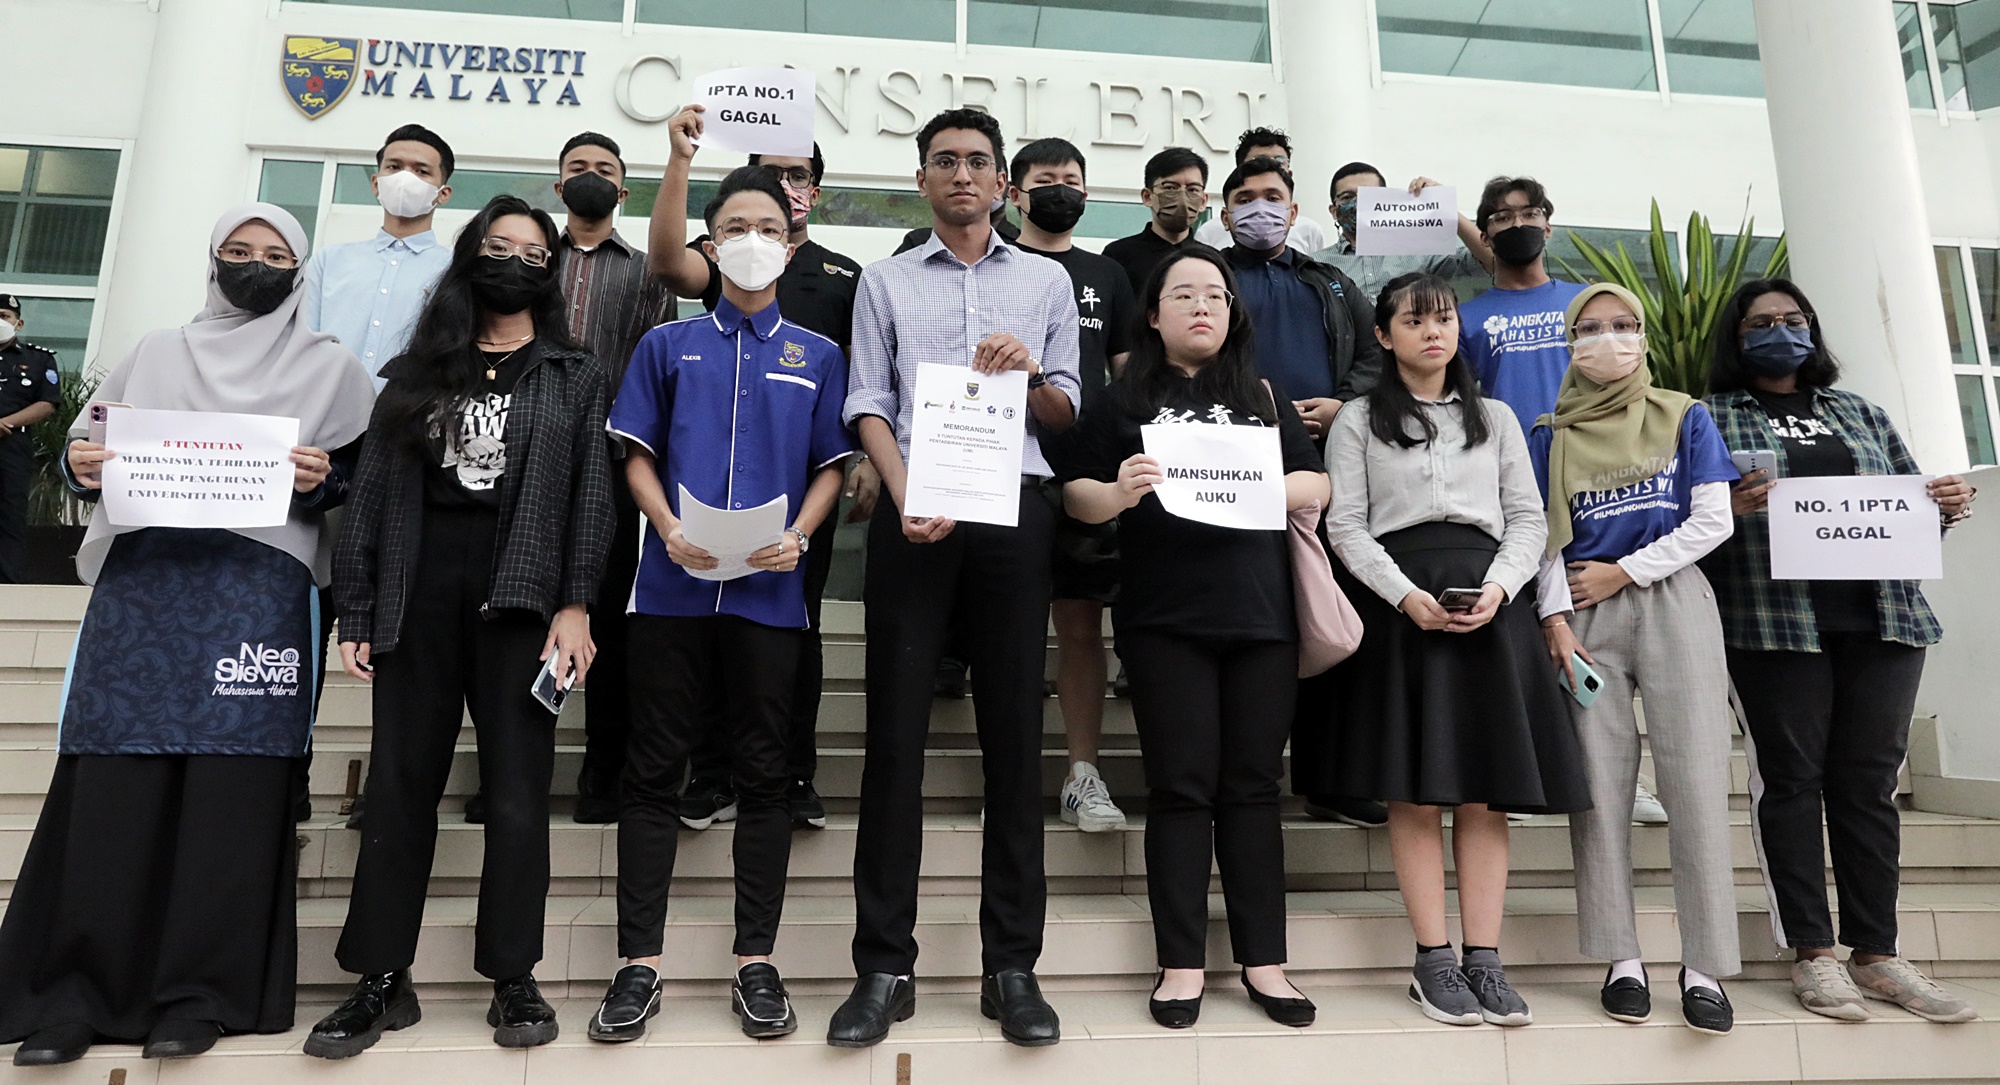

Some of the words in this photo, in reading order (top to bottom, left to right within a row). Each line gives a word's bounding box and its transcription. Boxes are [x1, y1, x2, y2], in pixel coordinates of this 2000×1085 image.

[367, 39, 586, 76] UNIVERSITI
[361, 69, 581, 106] MALAYA
[708, 85, 748, 97] IPTA
[754, 87, 795, 100] NO.1
[614, 54, 1268, 153] CNSELERI
[720, 110, 781, 126] GAGAL
[1374, 202, 1439, 212] AUTONOMI
[1370, 219, 1443, 227] MAHASISWA
[1510, 311, 1565, 328] ANGKATA
[1489, 325, 1565, 349] MAHASISW
[943, 423, 996, 435] MEMORANDUM
[163, 440, 171, 448] 8
[174, 441, 243, 450] TUNTUTAN
[121, 456, 203, 466] MAHASISWA
[207, 459, 279, 468] TERHADAP
[130, 473, 175, 481] PIHAK
[180, 475, 266, 484] PENGURUSAN
[1167, 468, 1263, 481] MANSUHKAN
[128, 490, 206, 500] UNIVERSITI
[210, 492, 264, 501] MALAYA
[1196, 492, 1236, 504] AUKU
[1795, 500, 1832, 512] NO.
[1840, 500, 1849, 512] 1
[1860, 499, 1910, 512] IPTA
[1816, 526, 1891, 539] GAGAL
[215, 658, 298, 683] Siswa
[212, 683, 265, 696] Mahasiswa
[267, 684, 299, 696] Hibrid
